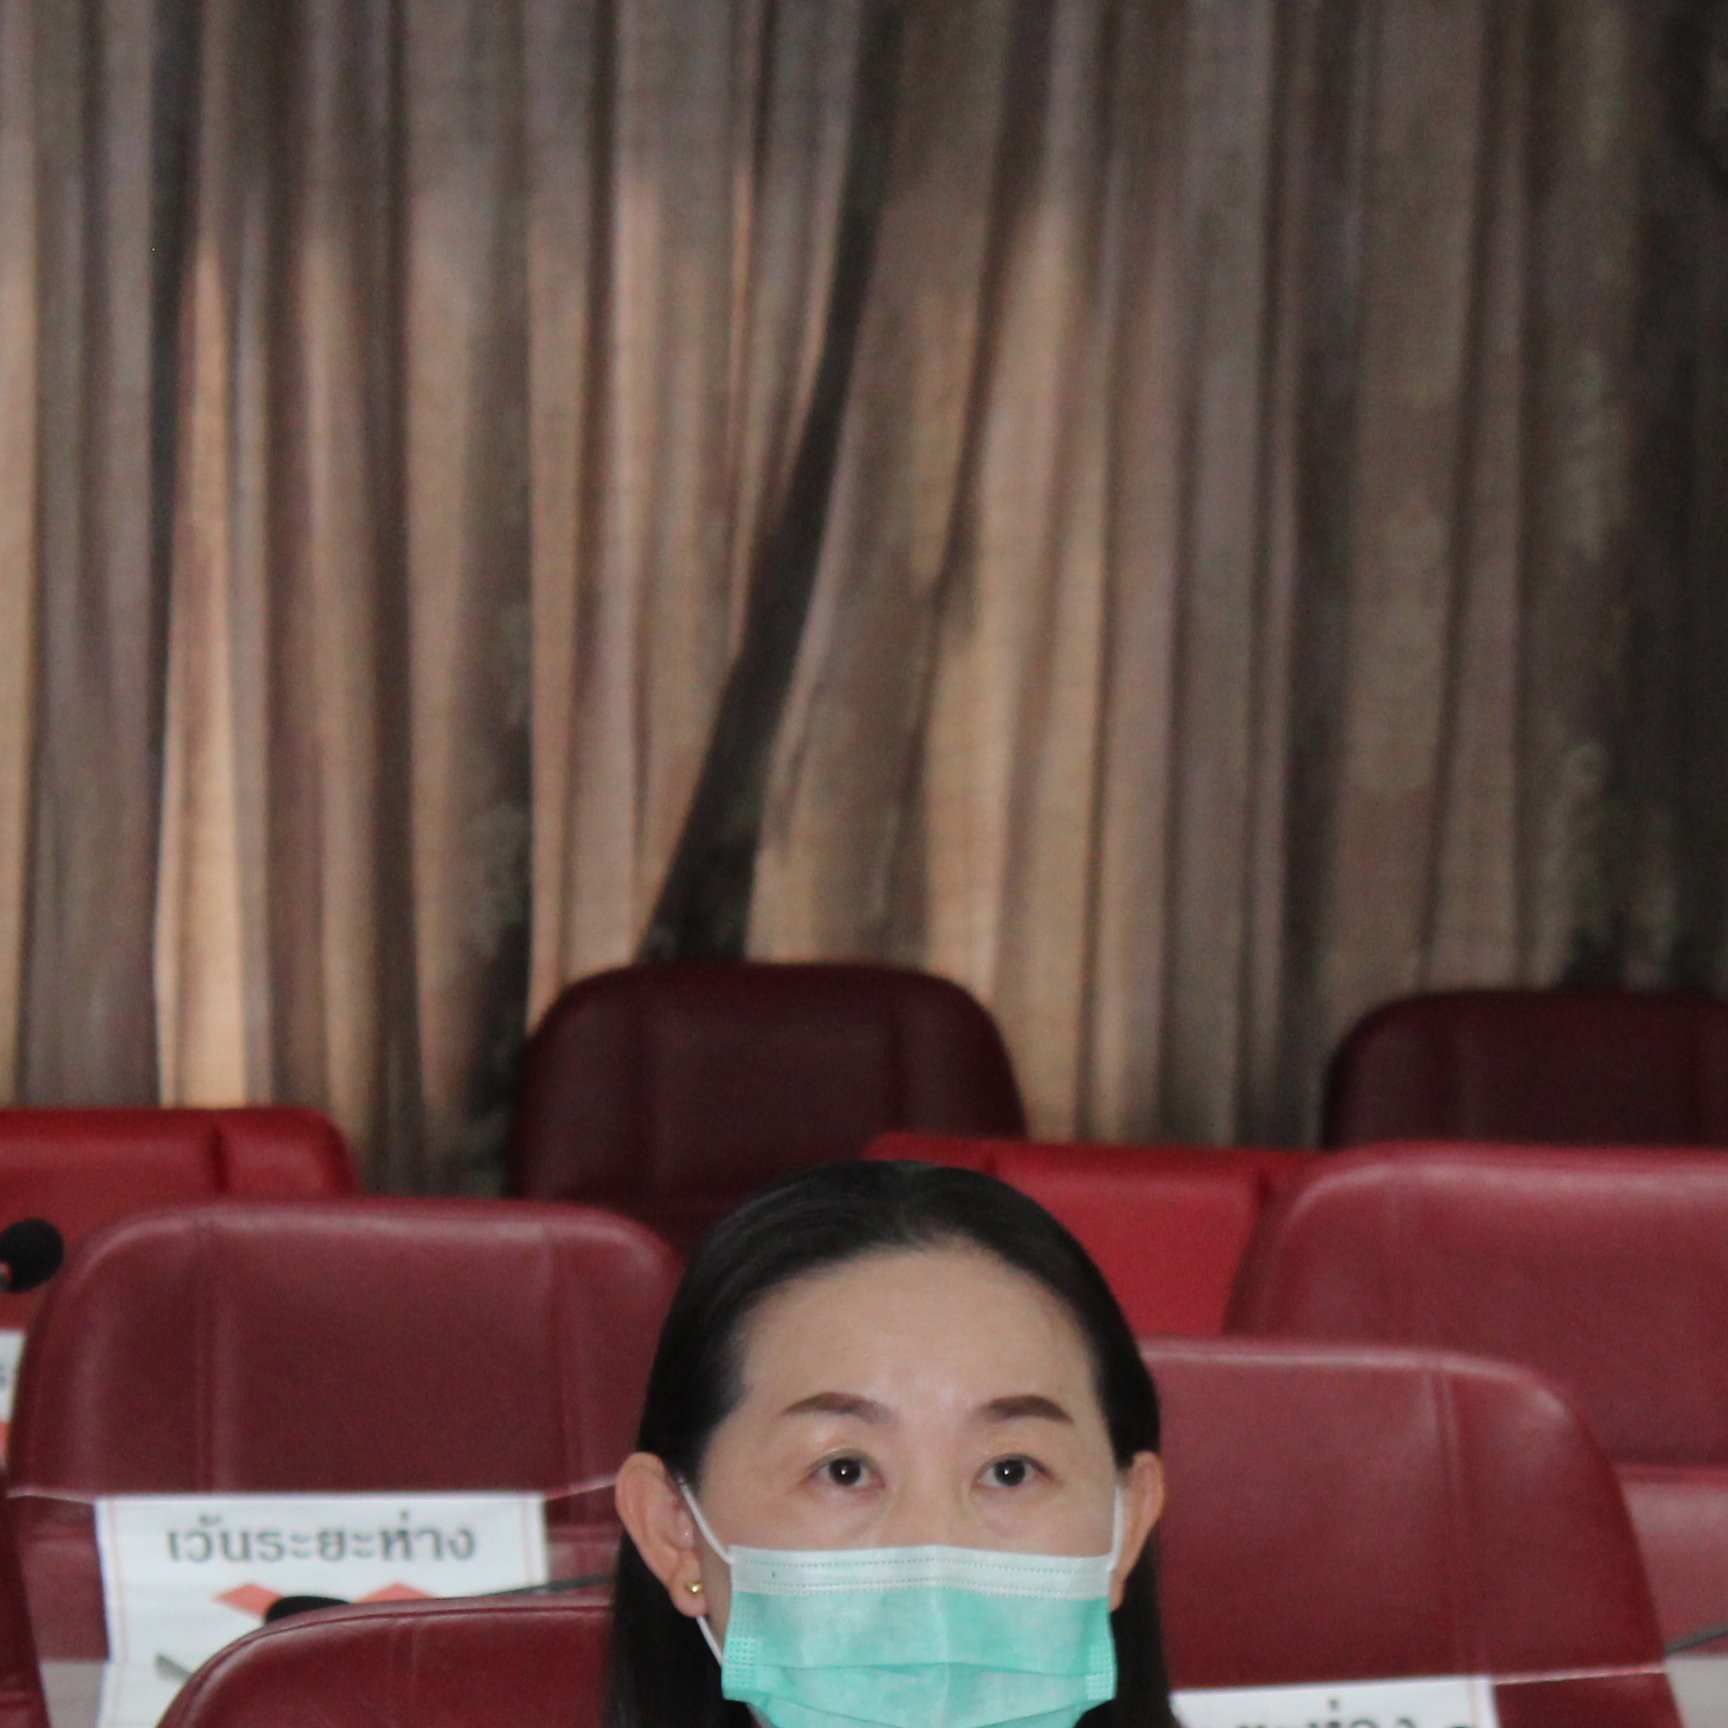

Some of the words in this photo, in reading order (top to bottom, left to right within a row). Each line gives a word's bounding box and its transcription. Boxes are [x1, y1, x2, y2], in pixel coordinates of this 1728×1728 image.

[167, 1508, 477, 1565] เว้นระยะห่าง
